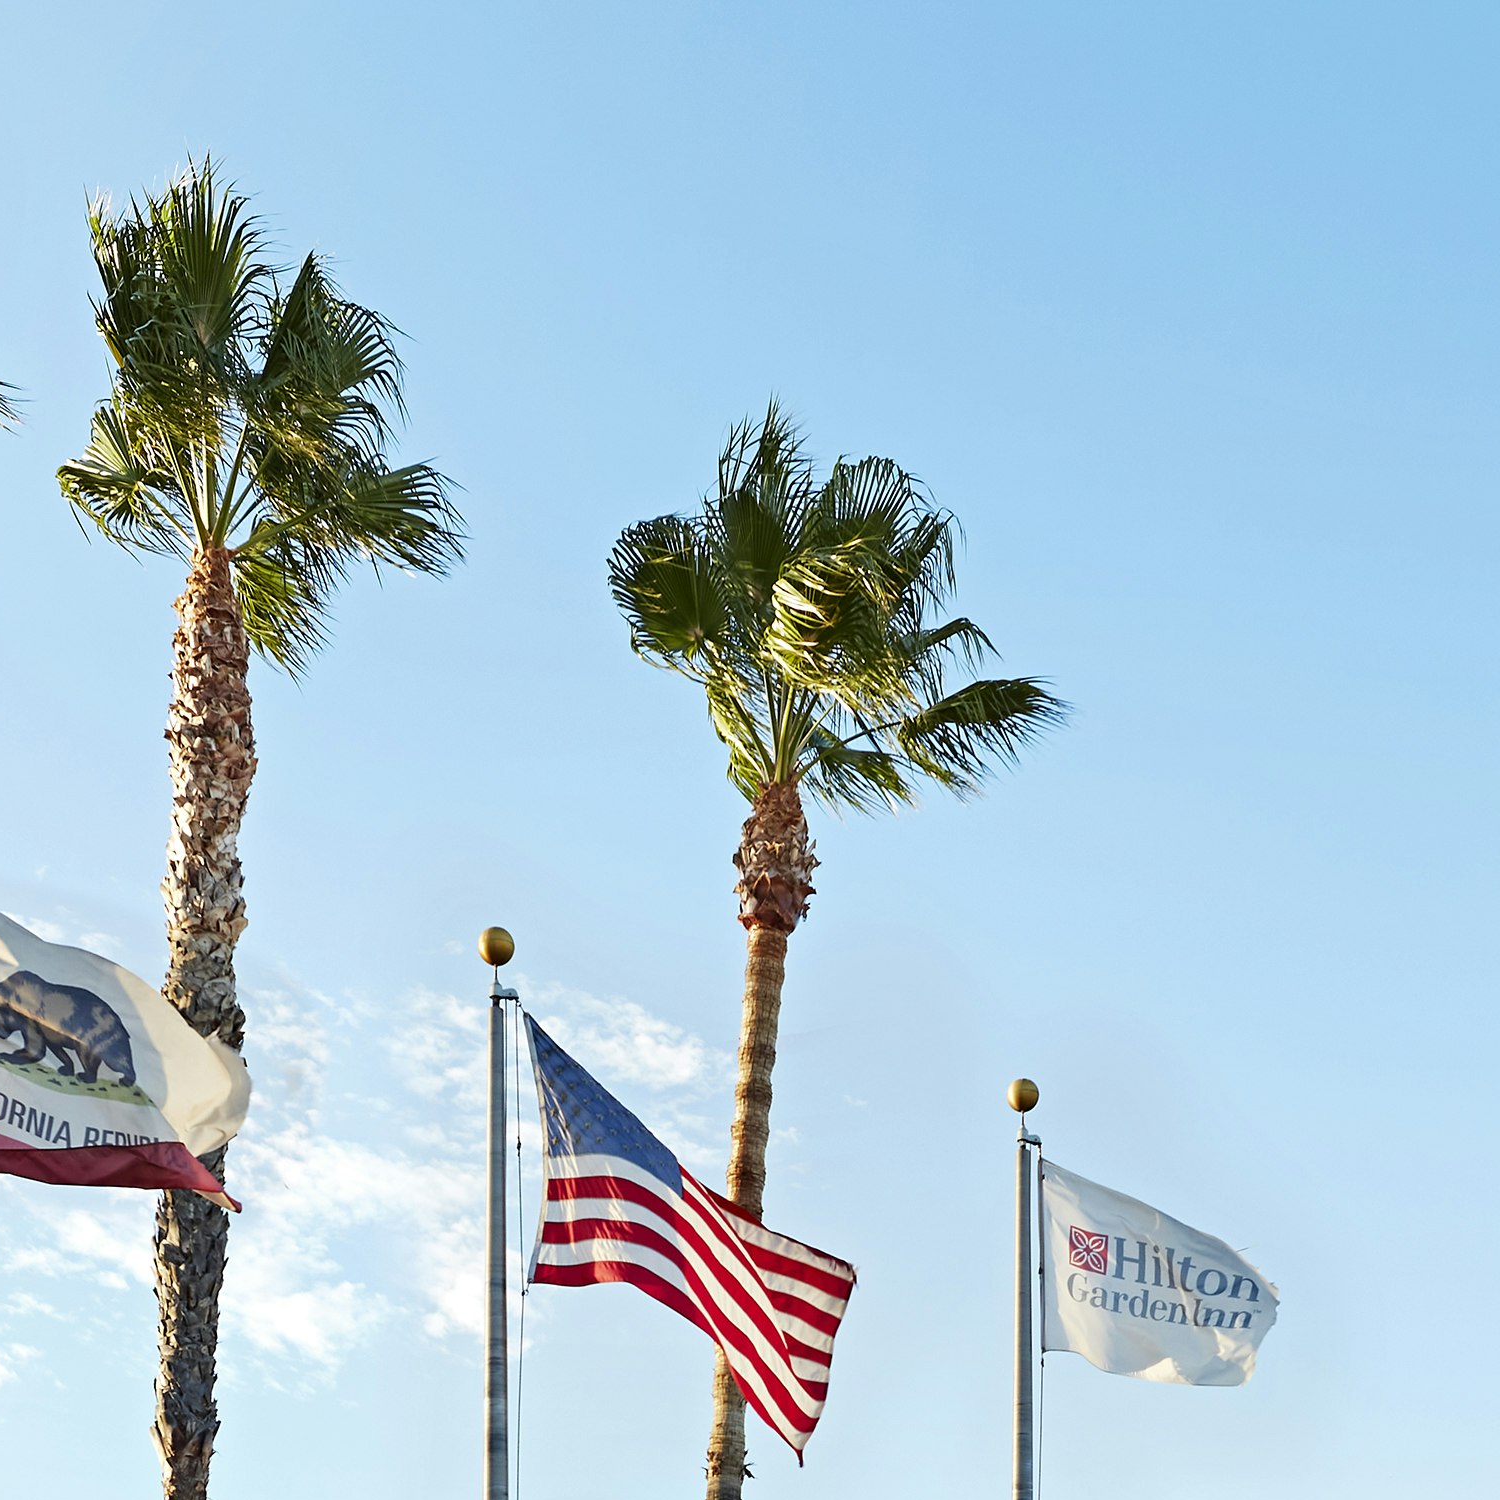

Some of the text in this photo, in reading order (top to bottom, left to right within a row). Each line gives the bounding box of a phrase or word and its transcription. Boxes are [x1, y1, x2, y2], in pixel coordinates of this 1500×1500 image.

[1112, 1237, 1259, 1302] Hilton
[1067, 1273, 1252, 1329] Garden Inn
